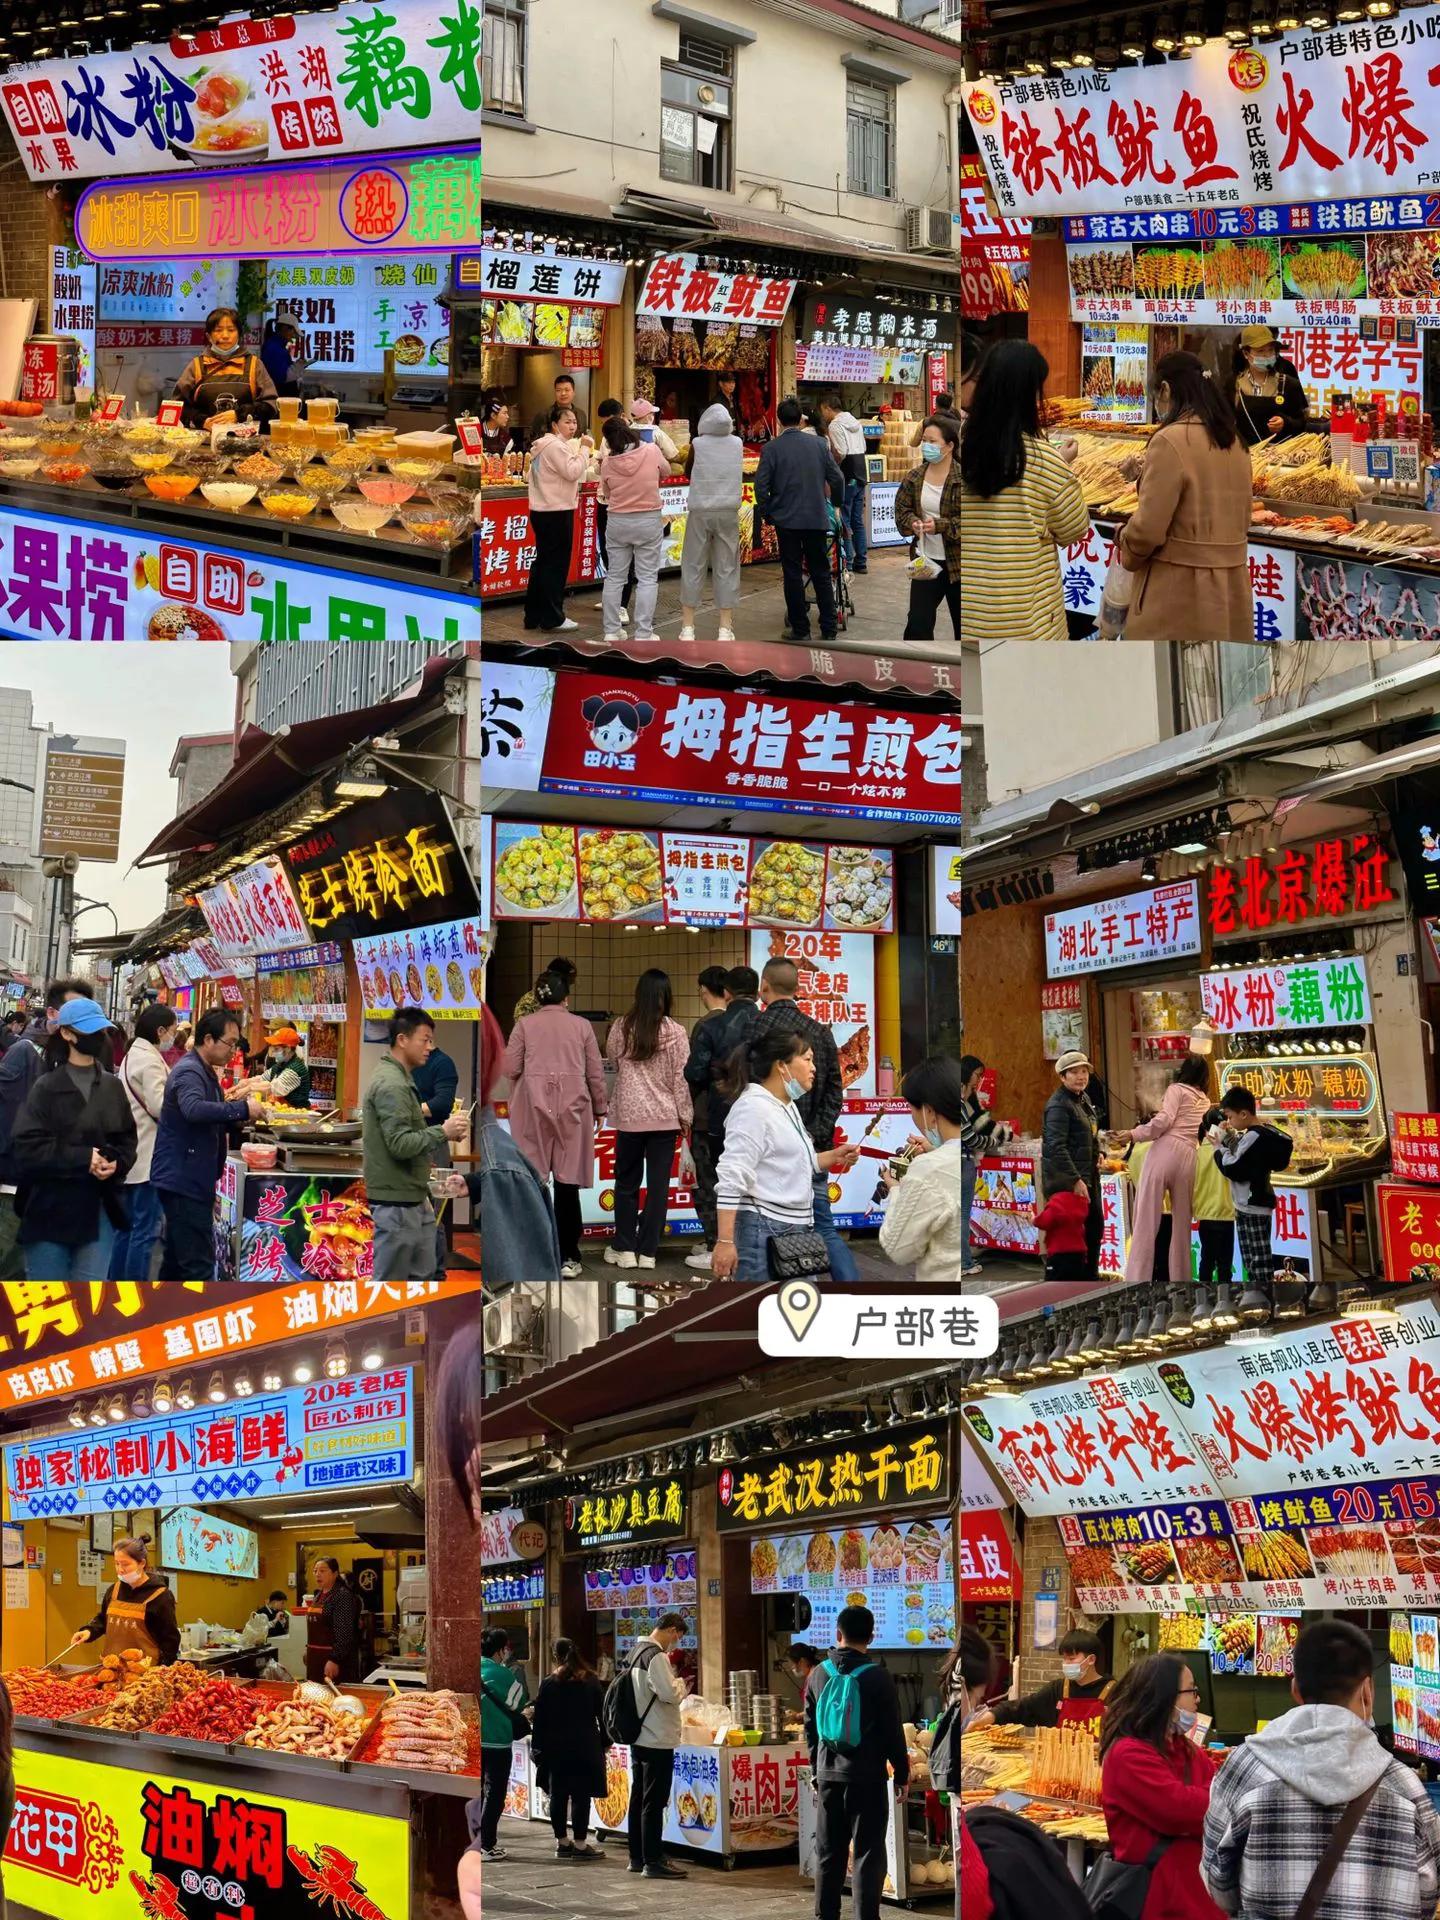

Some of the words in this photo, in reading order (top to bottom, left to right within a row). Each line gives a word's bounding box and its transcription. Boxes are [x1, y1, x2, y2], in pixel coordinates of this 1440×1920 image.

[187, 20, 277, 52] 武汉总店
[259, 45, 334, 98] 洪湖
[999, 72, 1111, 105] 户部巷特色小吃
[10, 89, 60, 128] 自助
[62, 56, 197, 155] 冰粉
[1276, 52, 1440, 177] 火爆
[279, 102, 341, 143] 传统
[26, 138, 79, 173] 水果
[1001, 90, 1240, 197] 铁板鱿鱼
[1241, 103, 1274, 193] 祝氏烧烤
[982, 134, 1016, 208] 祝氏烧烤
[88, 191, 198, 249] 冰甜爽口
[208, 174, 321, 246] 冰粉
[354, 173, 395, 234] 热
[410, 156, 480, 240] 藕
[1124, 192, 1173, 207] 户部巷美食
[1175, 187, 1240, 205] 二十五年老店
[54, 274, 81, 300] 酸奶
[101, 268, 174, 298] 凉爽冰粉
[277, 266, 355, 286] 水果双皮奶
[382, 263, 452, 285] 烧仙
[486, 258, 602, 298] 榴莲饼
[644, 256, 792, 319] 铁板鱿鱼
[54, 304, 94, 330] 水果捞
[276, 298, 335, 324] 酸奶
[1076, 299, 1133, 312] 蒙古大肉串
[1089, 312, 1120, 321] 10元3串
[1145, 300, 1197, 313] 面筋大王
[1154, 312, 1188, 323] 10元4串
[1216, 300, 1272, 314] 烤小肉串
[1222, 314, 1267, 325] 10元30串
[1295, 300, 1356, 314] 铁板鸭肠
[1301, 315, 1352, 326] 10元40串
[97, 328, 193, 347] 酸奶水果捞
[374, 299, 396, 349] 手工
[832, 307, 938, 339] 孝感糊米酒
[931, 361, 945, 408] 老味
[0, 525, 128, 640] 果捞
[165, 553, 241, 607] 自助
[601, 689, 641, 704] TIANXIAOYU
[660, 692, 961, 786] 拇指生煎包
[583, 749, 637, 771] 田小玉
[725, 771, 789, 790] 香香脆脆
[801, 781, 908, 800] 一口一个炫不停
[667, 849, 745, 871] 拇指生煎包
[298, 829, 445, 927] 芝士烤冷面
[1207, 834, 1393, 935] 老北京爆肚
[1057, 898, 1194, 961] 湖北手工特产
[784, 933, 842, 962] 20年
[1212, 973, 1275, 1030] 冰粉
[1287, 962, 1365, 1025] 藕粉
[1273, 1068, 1314, 1098] 冰粉
[1322, 1067, 1368, 1098] 藕粉
[254, 1184, 346, 1227] 芝士
[7, 1358, 76, 1400] 皮皮虾
[90, 1339, 144, 1379] 螃蟹
[163, 1306, 258, 1361] 基围虾
[1237, 1315, 1440, 1379] 南海舰队退伍老兵再创业
[303, 1370, 407, 1405] 20年老店
[1029, 1377, 1160, 1419] 南海舰队退伍老兵再创业
[312, 1400, 397, 1427] 匠心制作
[15, 1405, 289, 1494] 独家秘制小海鲜
[312, 1456, 397, 1482] 地道武汉味
[733, 1434, 943, 1522] 老武汉热干面
[1287, 1461, 1381, 1484] 户部巷名小吃
[578, 1480, 682, 1535] 老长沙臭豆腐
[1068, 1492, 1131, 1508] 户部巷名小吃
[1141, 1483, 1213, 1502] 二十三年老店
[1259, 1481, 1440, 1529] 烤鱿鱼20元15
[518, 1531, 544, 1548] 代记
[1082, 1507, 1223, 1543] 西北烤肉10元3串
[1079, 1587, 1129, 1603] 大西北肉串
[1135, 1586, 1182, 1601] 烤面筋
[1263, 1582, 1304, 1598] 烤鸭肠
[1323, 1577, 1398, 1595] 烤小牛肉串
[1345, 1594, 1389, 1605] 10元30串
[1267, 1598, 1306, 1609] 10元40串
[1210, 1652, 1254, 1674] 10元4串
[730, 1756, 754, 1818] 爆汁
[10, 1800, 78, 1868] 花甲
[142, 1783, 285, 1890] 油焖
[183, 1873, 243, 1905] 超有料
